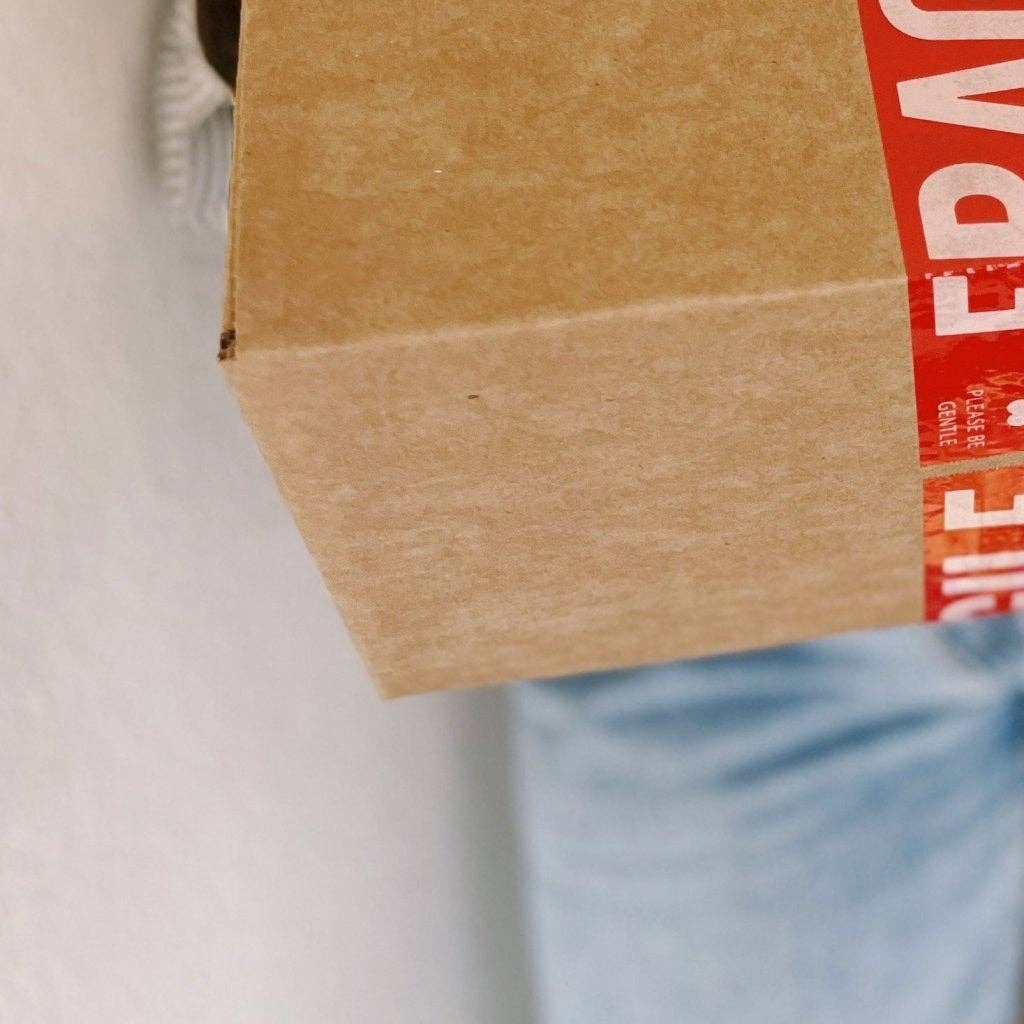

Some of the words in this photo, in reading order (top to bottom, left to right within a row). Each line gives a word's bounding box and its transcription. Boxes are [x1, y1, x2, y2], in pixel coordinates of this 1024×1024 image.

[938, 401, 957, 447] GENTLE
[966, 388, 986, 432] PLEASE
[967, 434, 986, 449] BE
